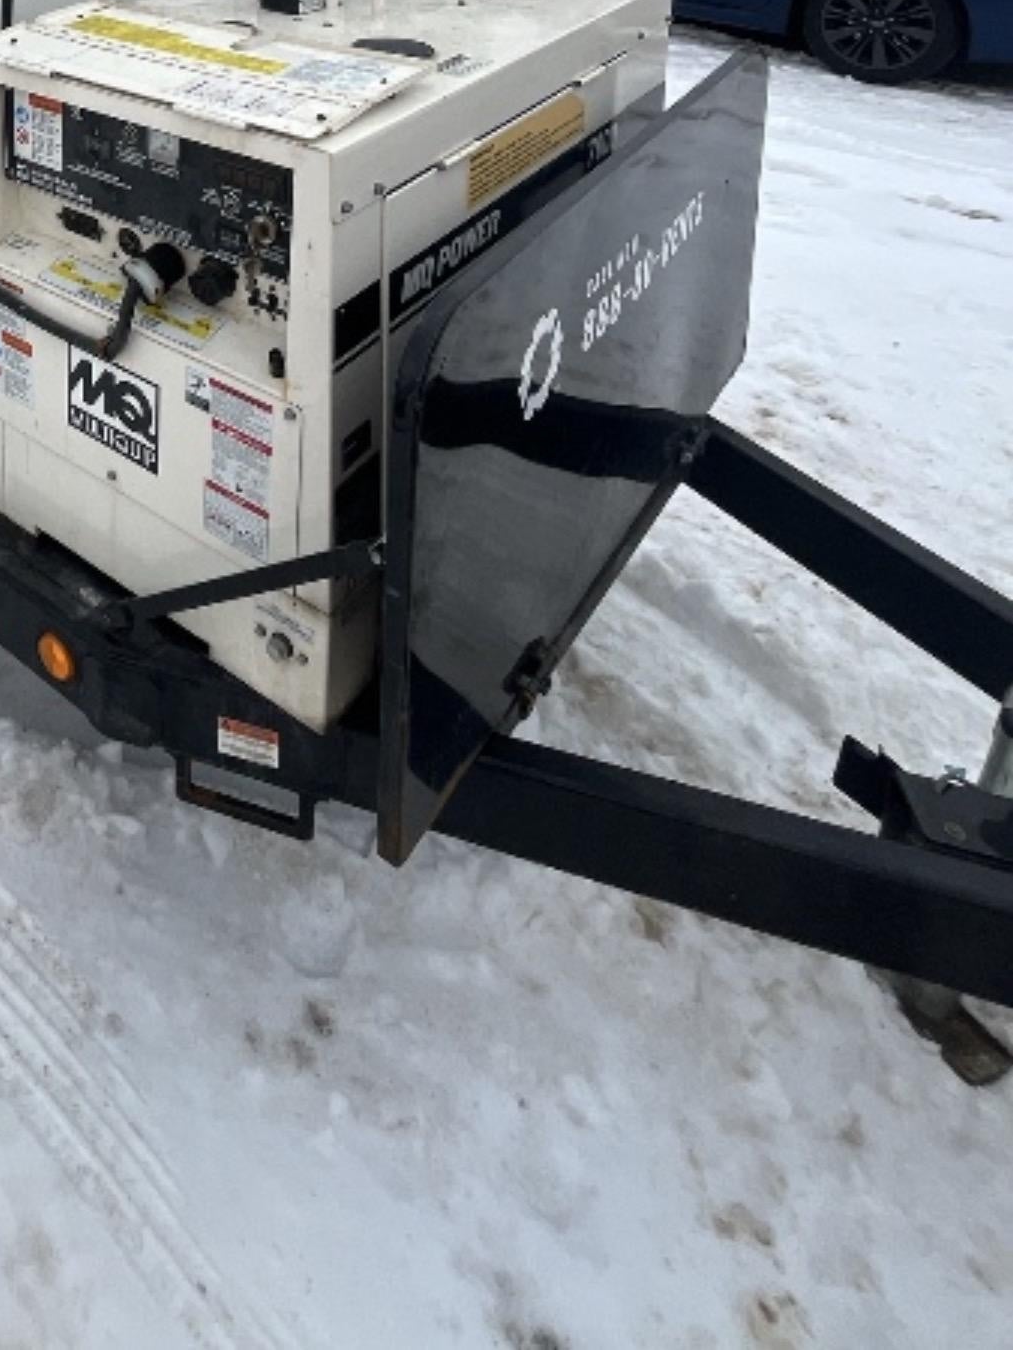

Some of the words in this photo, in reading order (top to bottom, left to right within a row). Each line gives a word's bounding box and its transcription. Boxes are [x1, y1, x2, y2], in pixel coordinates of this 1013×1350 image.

[401, 255, 436, 303] MQ
[437, 209, 501, 276] POWER
[69, 358, 156, 442] MQ
